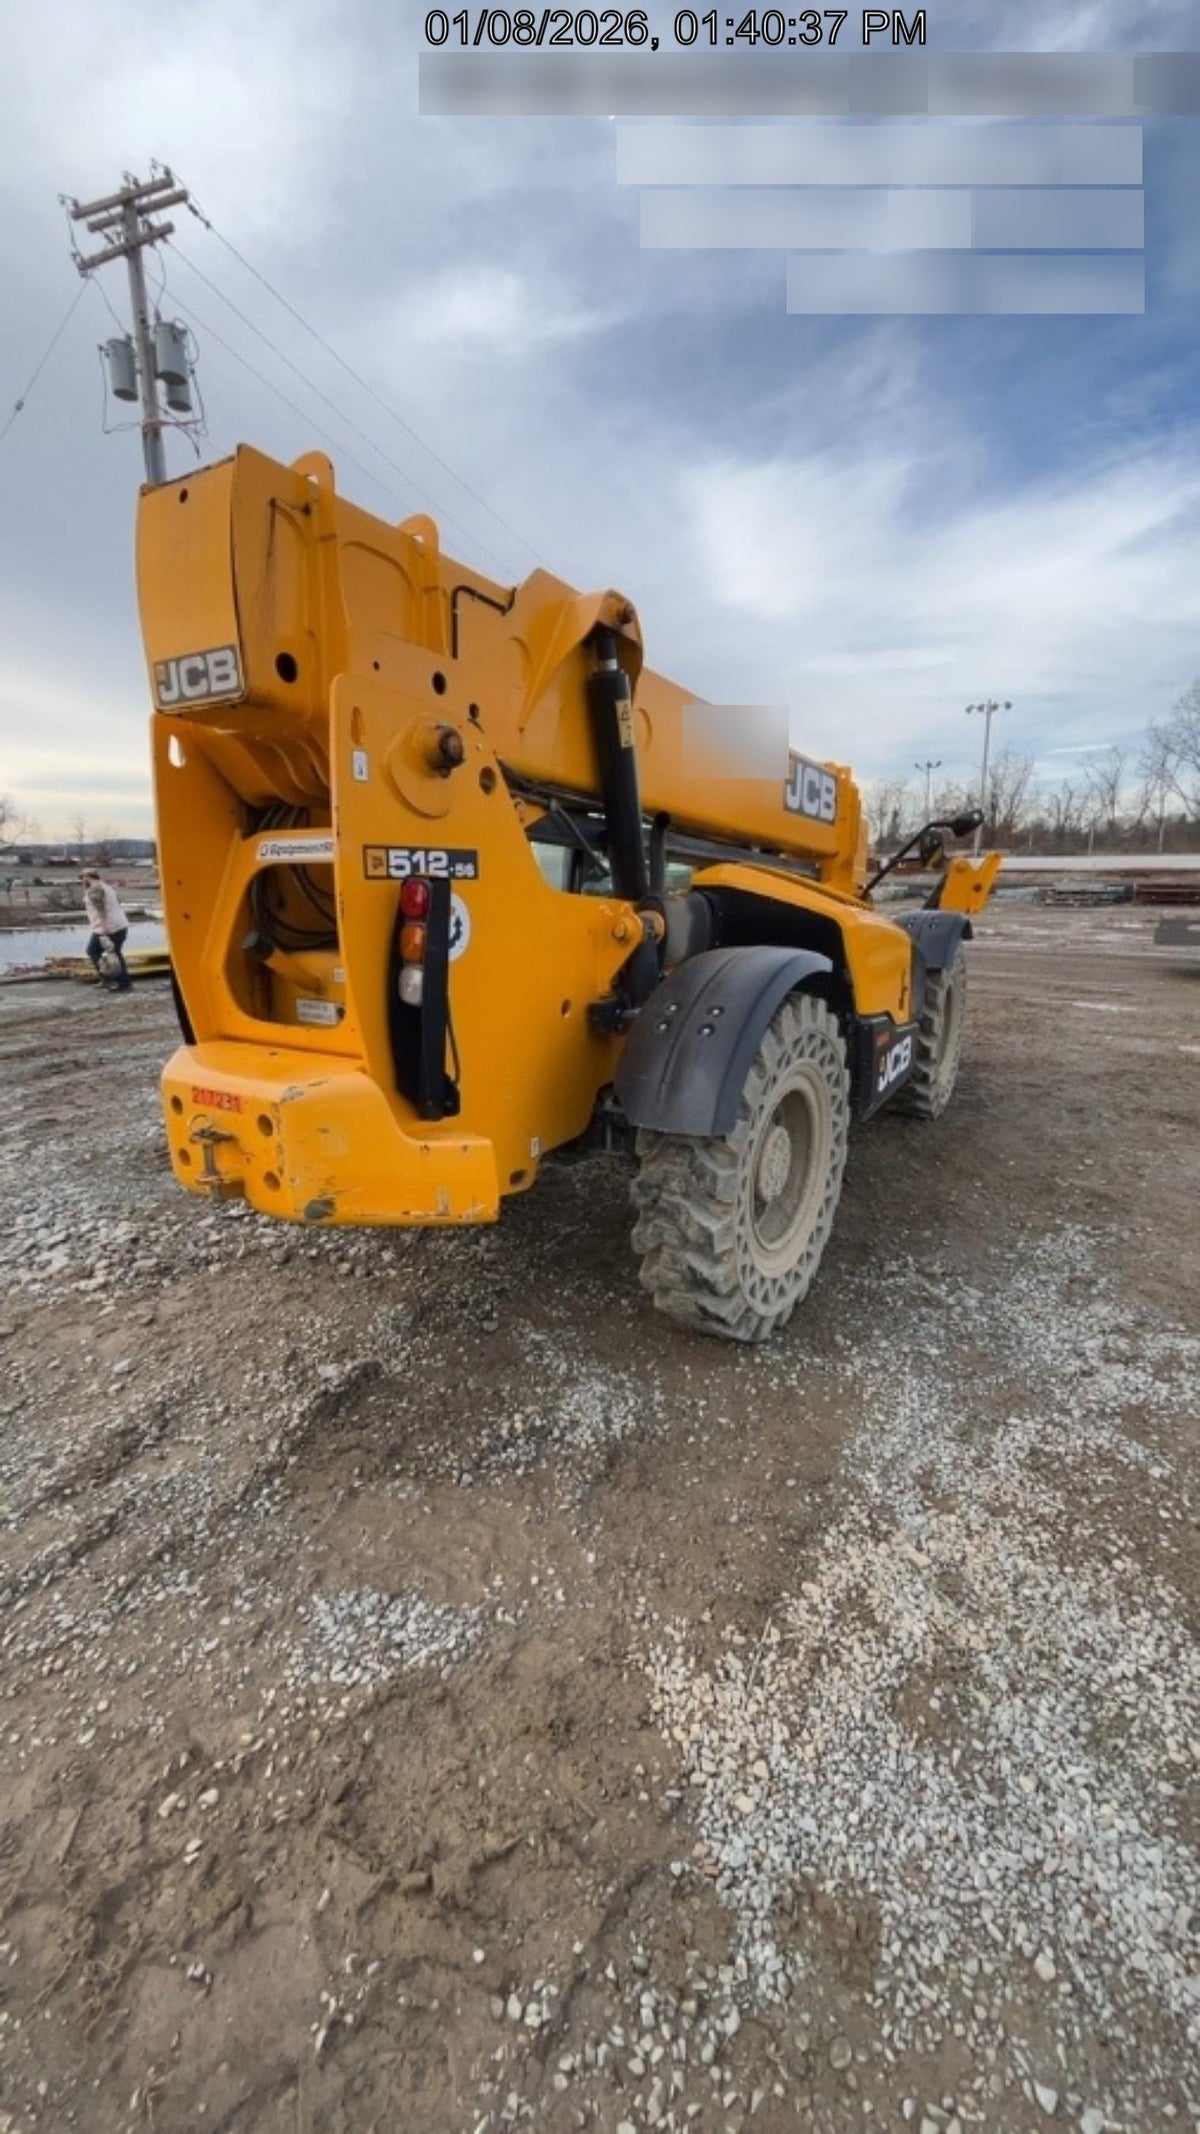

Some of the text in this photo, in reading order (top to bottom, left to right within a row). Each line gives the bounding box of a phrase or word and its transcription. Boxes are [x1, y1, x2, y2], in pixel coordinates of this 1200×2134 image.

[158, 648, 239, 701] JCB
[786, 761, 836, 821] JCB
[877, 1036, 912, 1091] JCB
